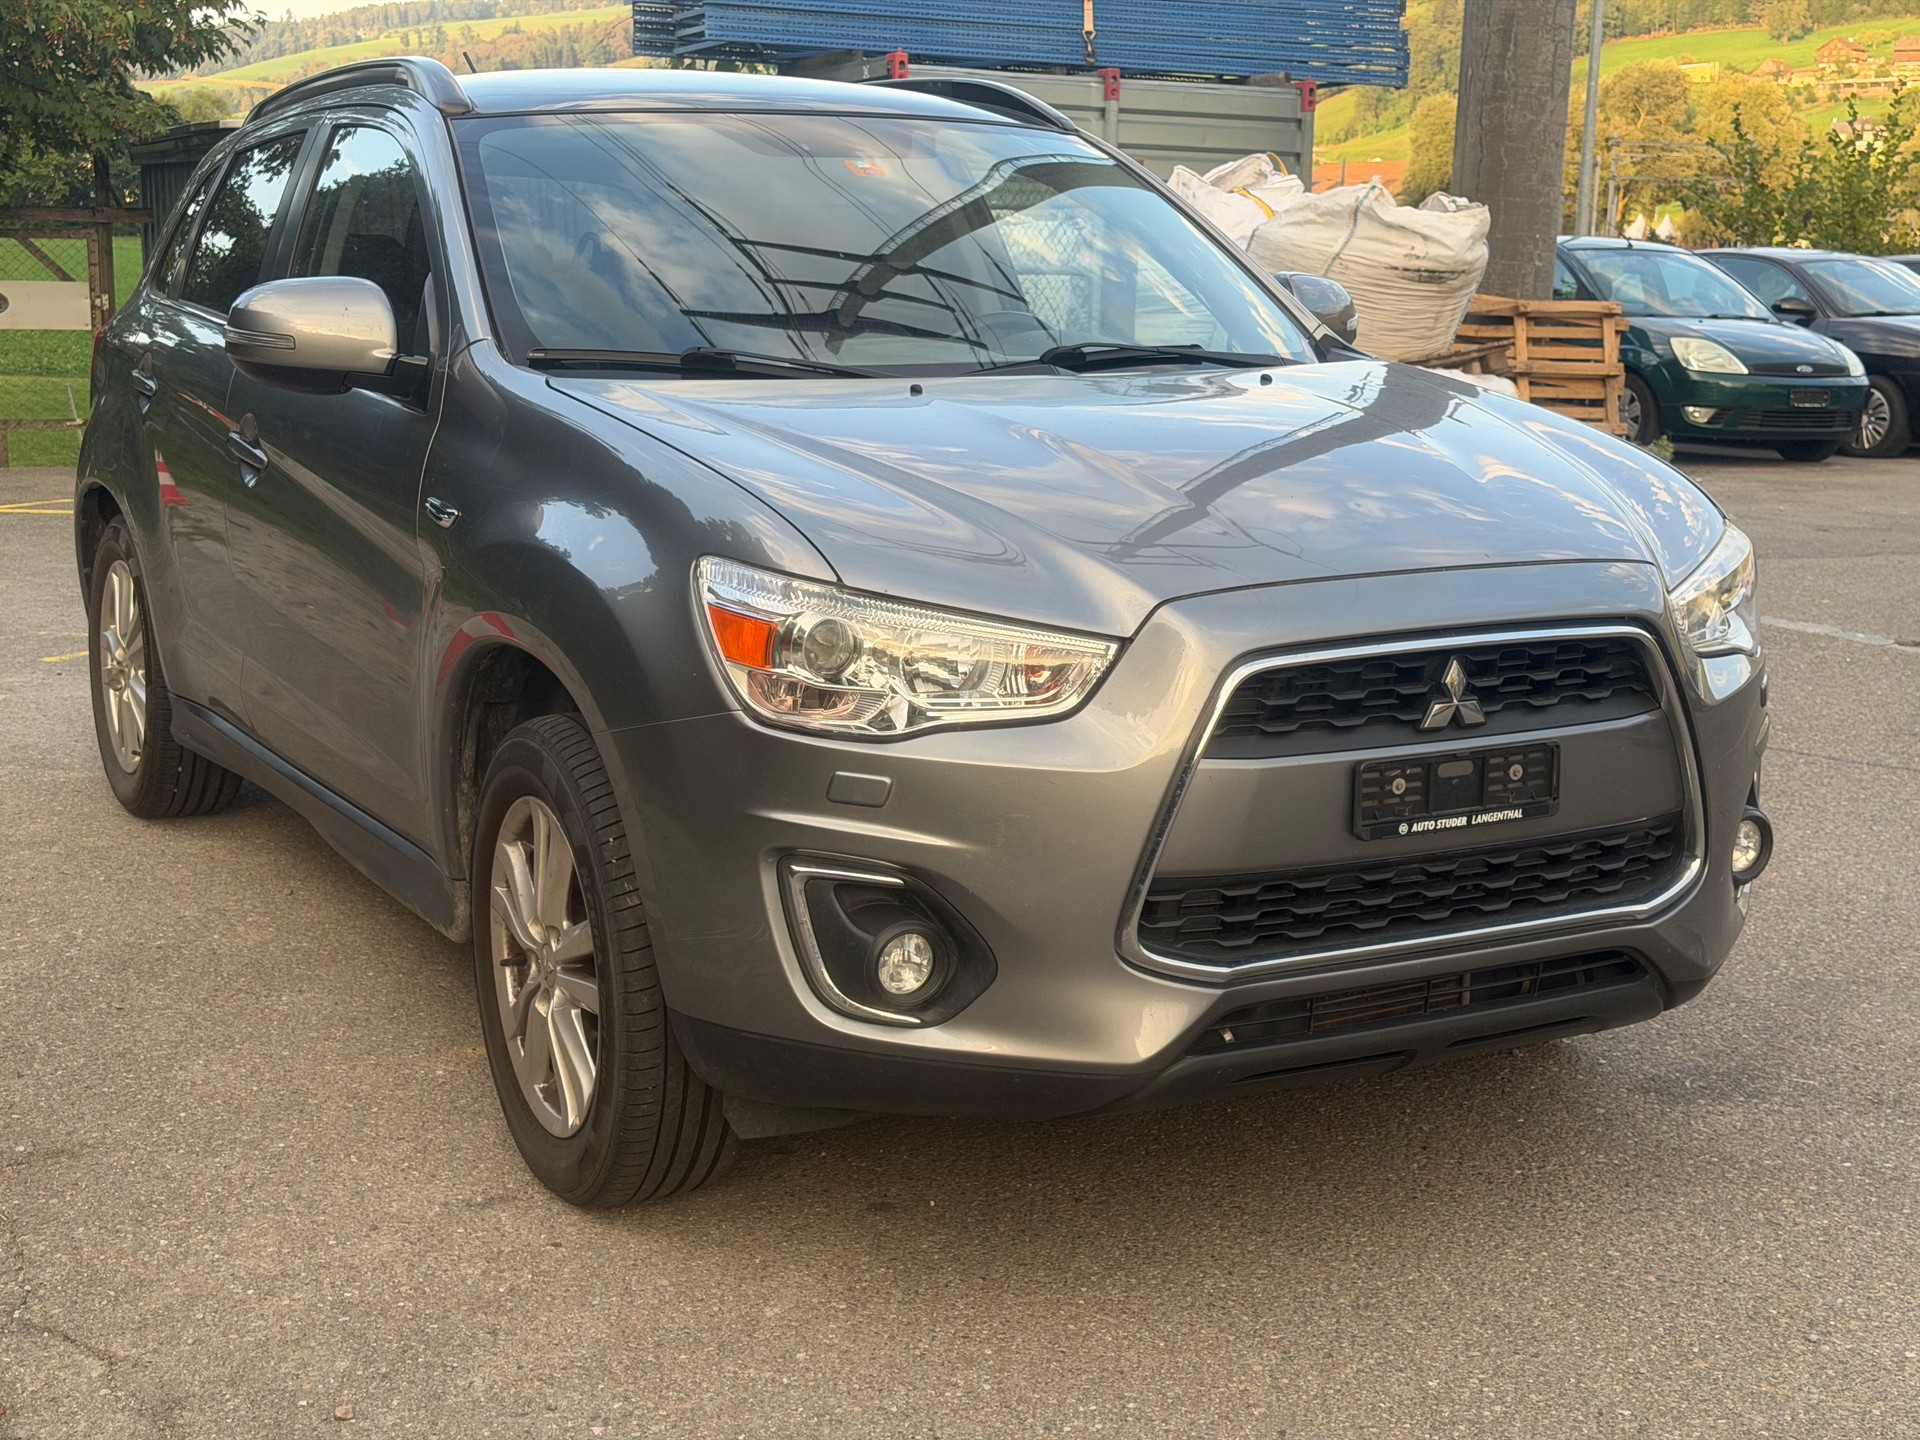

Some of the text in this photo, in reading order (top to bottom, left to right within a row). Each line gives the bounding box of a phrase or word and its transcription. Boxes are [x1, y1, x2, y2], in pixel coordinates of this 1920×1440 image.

[1411, 808, 1523, 832] AUTO STUDER LANGENTHAL
